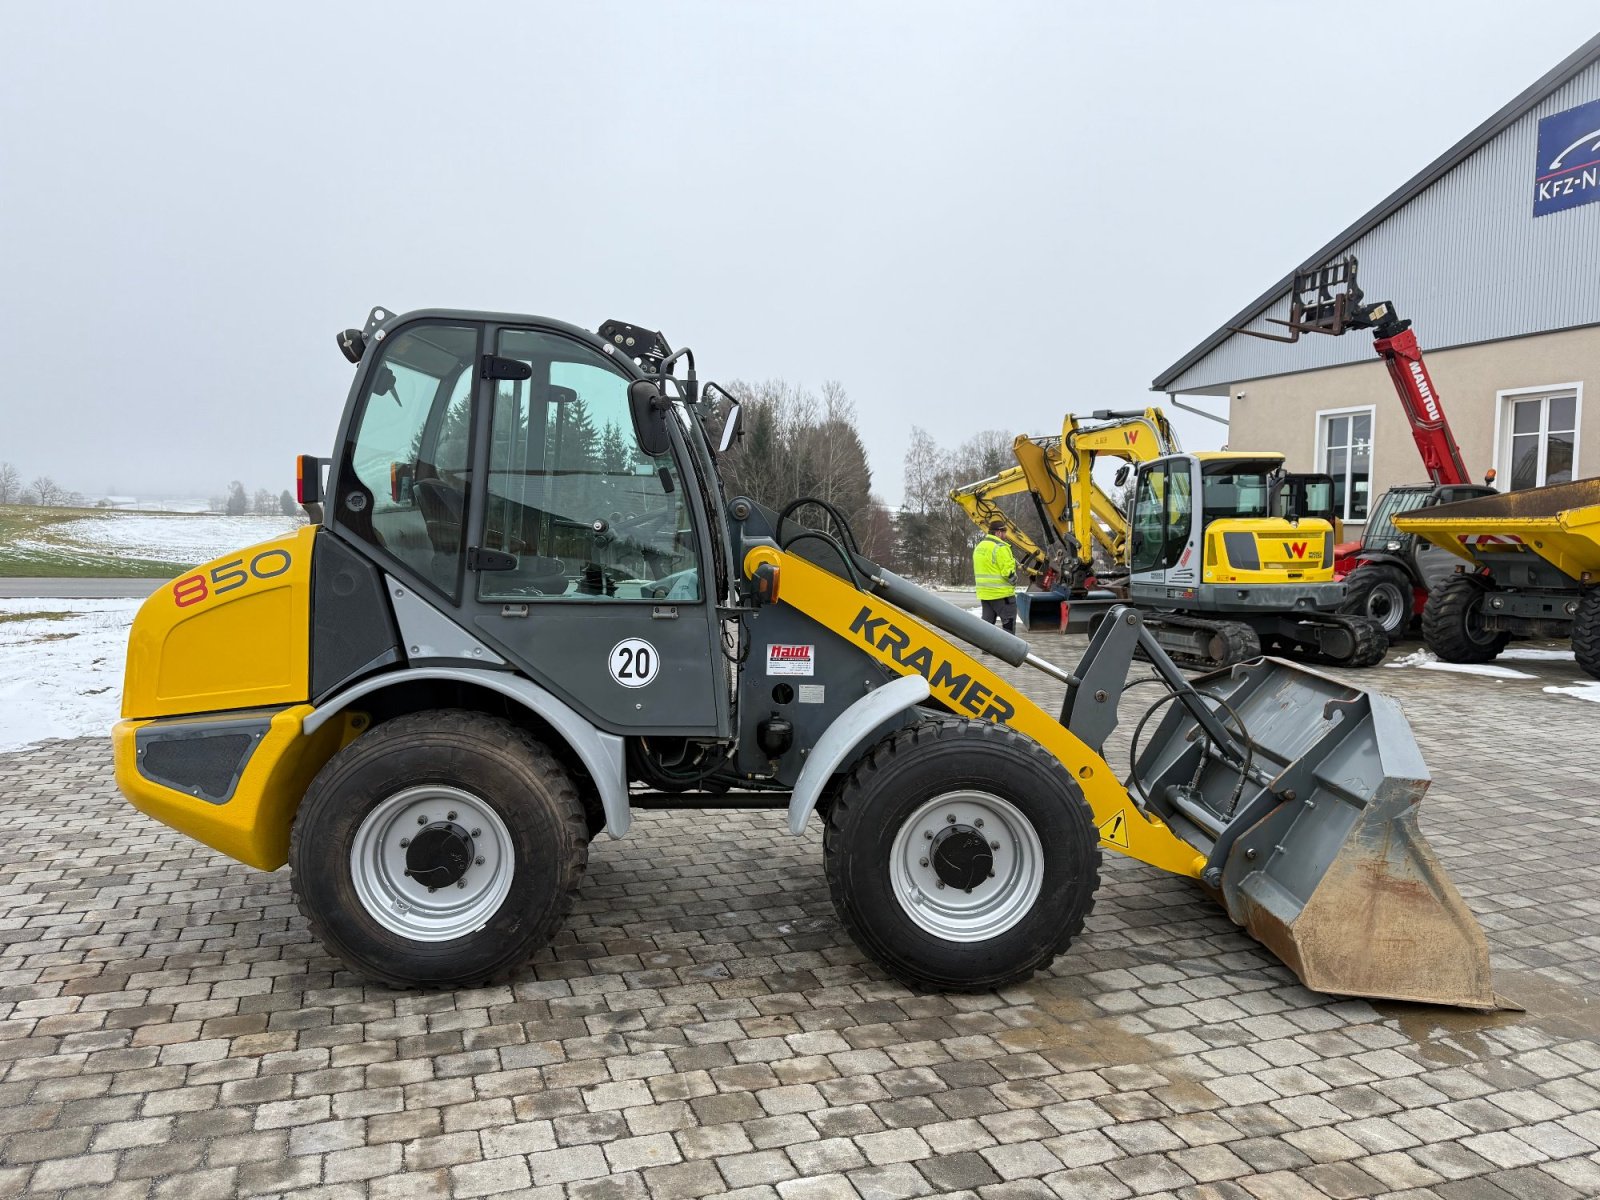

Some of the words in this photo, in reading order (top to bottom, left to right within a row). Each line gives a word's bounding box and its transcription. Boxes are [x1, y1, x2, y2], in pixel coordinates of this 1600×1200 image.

[1539, 167, 1600, 202] KFZ-N
[1408, 361, 1440, 421] MANITOU
[172, 549, 292, 608] 850
[618, 647, 651, 679] 20
[849, 606, 1016, 724] KRAMER
